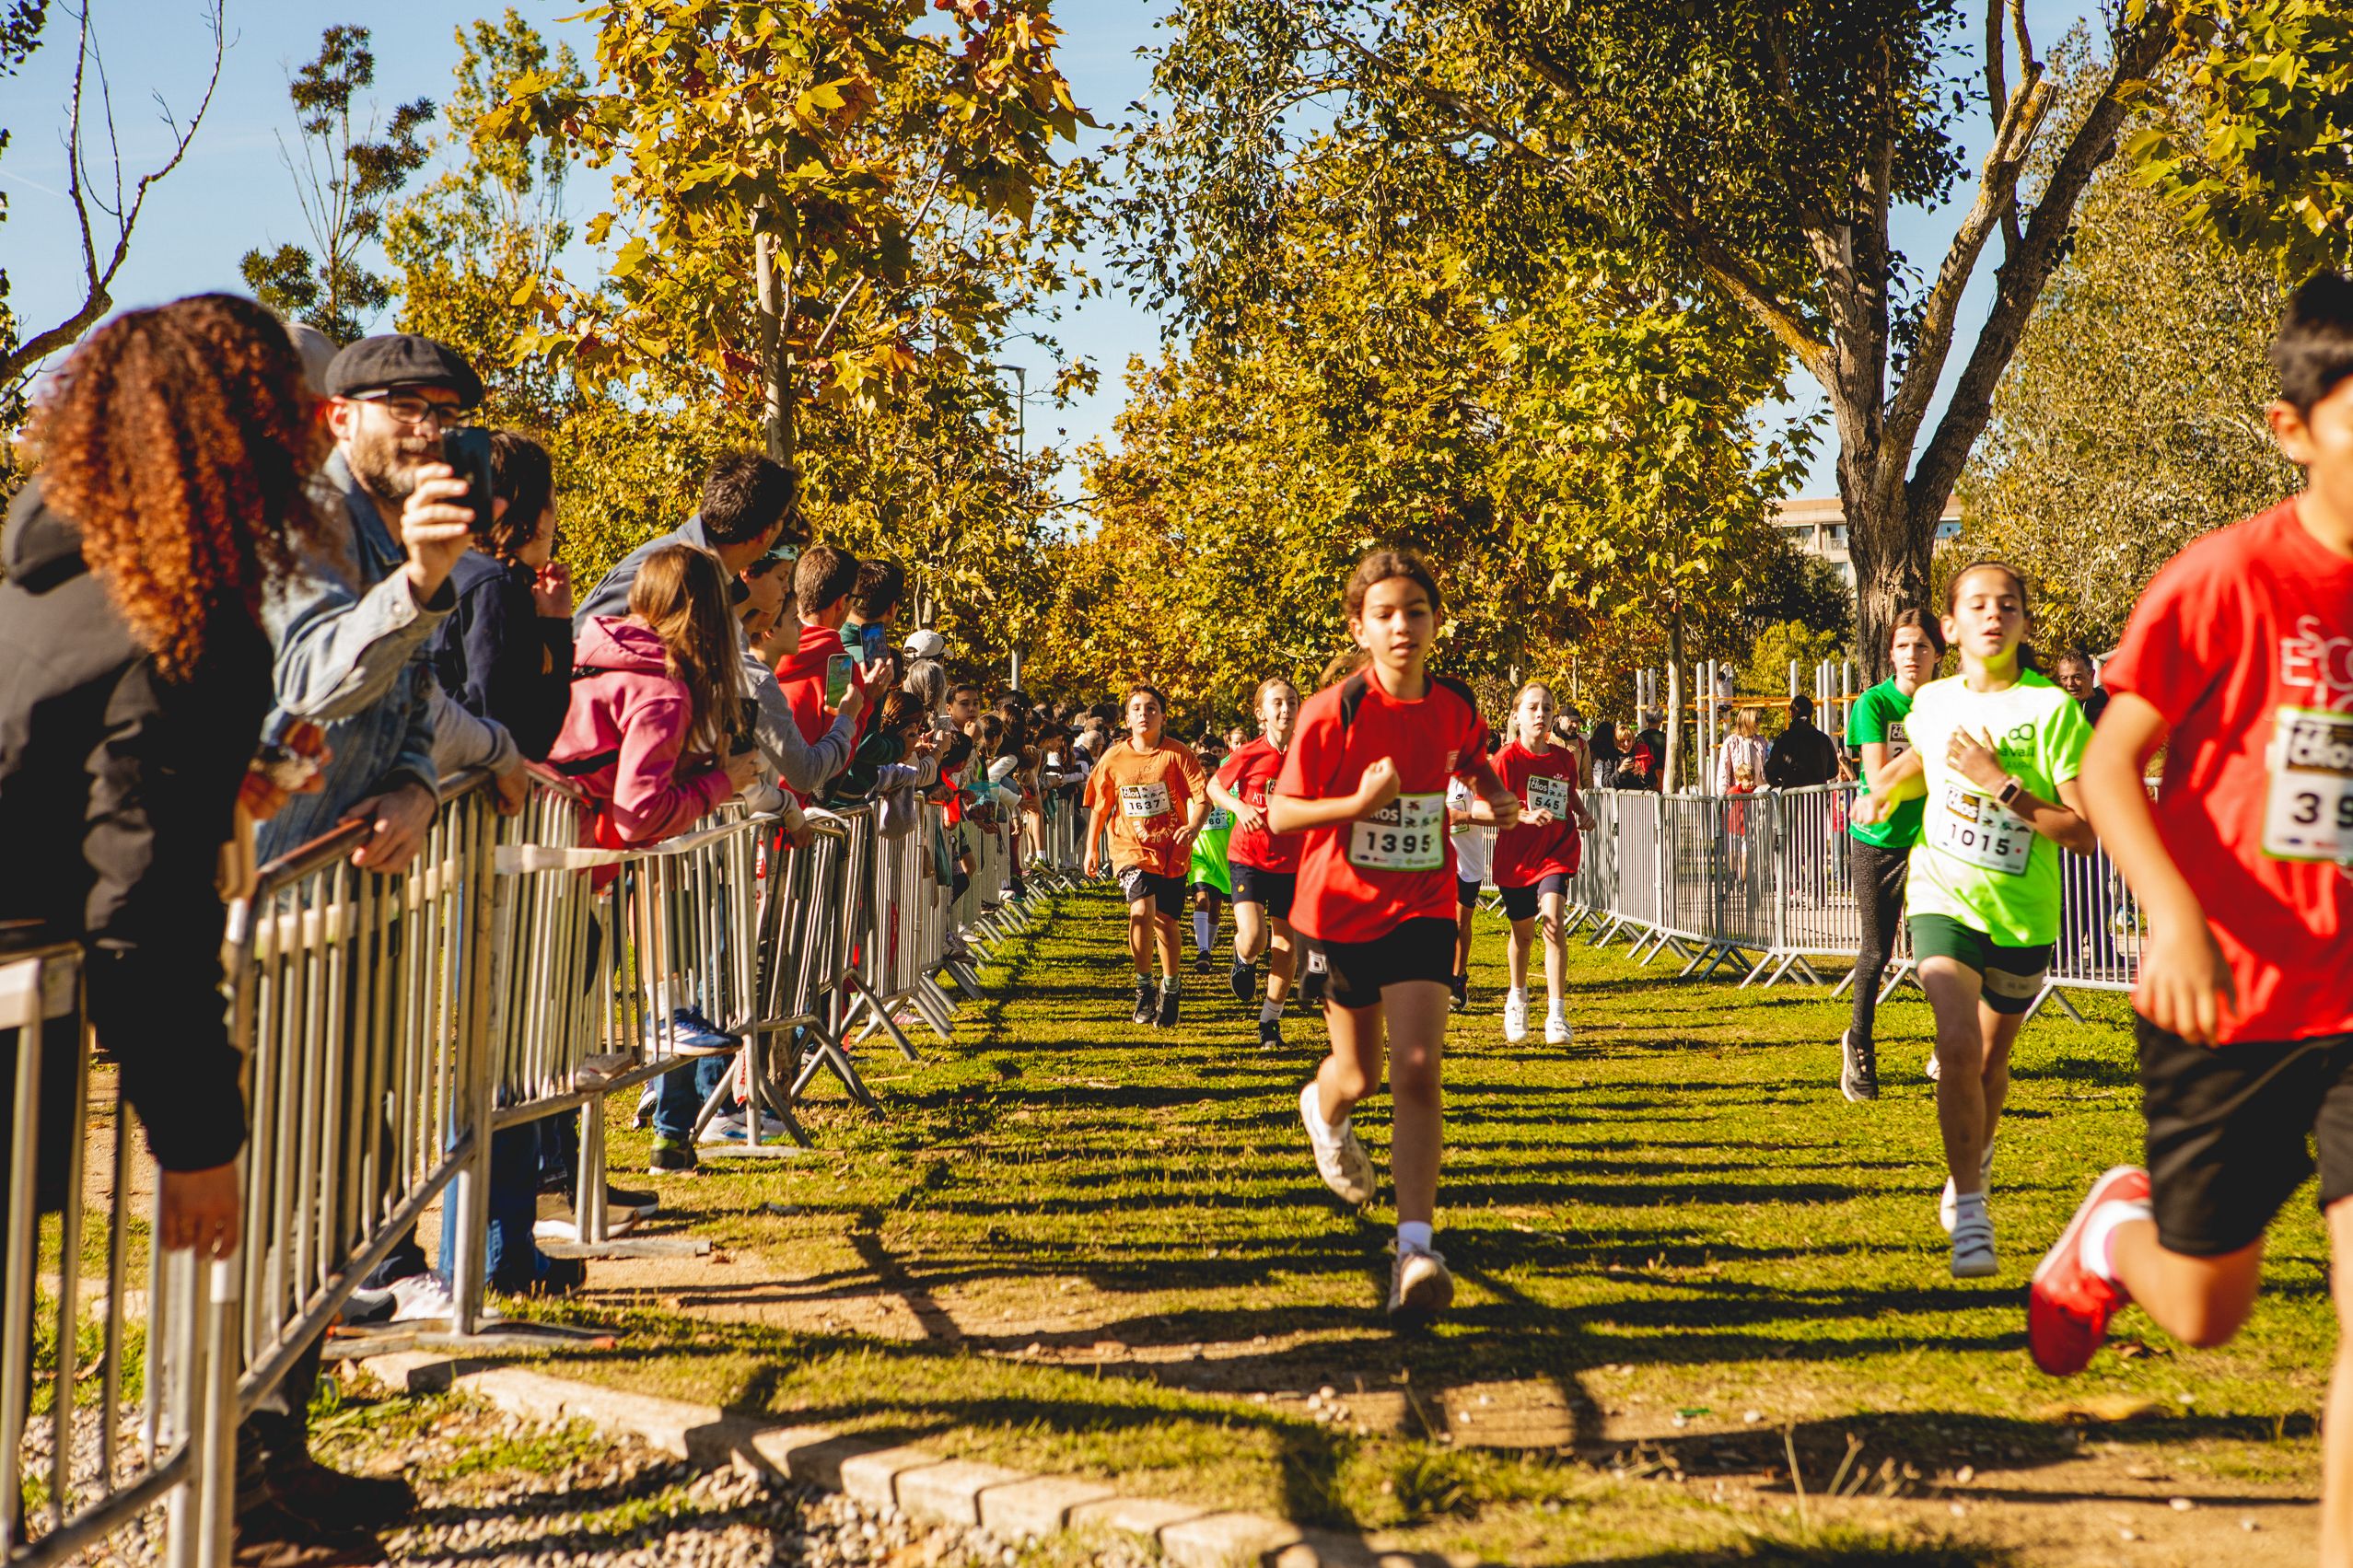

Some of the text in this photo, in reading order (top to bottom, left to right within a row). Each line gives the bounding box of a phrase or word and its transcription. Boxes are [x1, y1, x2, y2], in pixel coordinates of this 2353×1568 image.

[1129, 799, 1160, 810] 1637
[1534, 796, 1560, 810] 545
[1367, 831, 1431, 854] 1395
[1951, 823, 2011, 856] 1015
